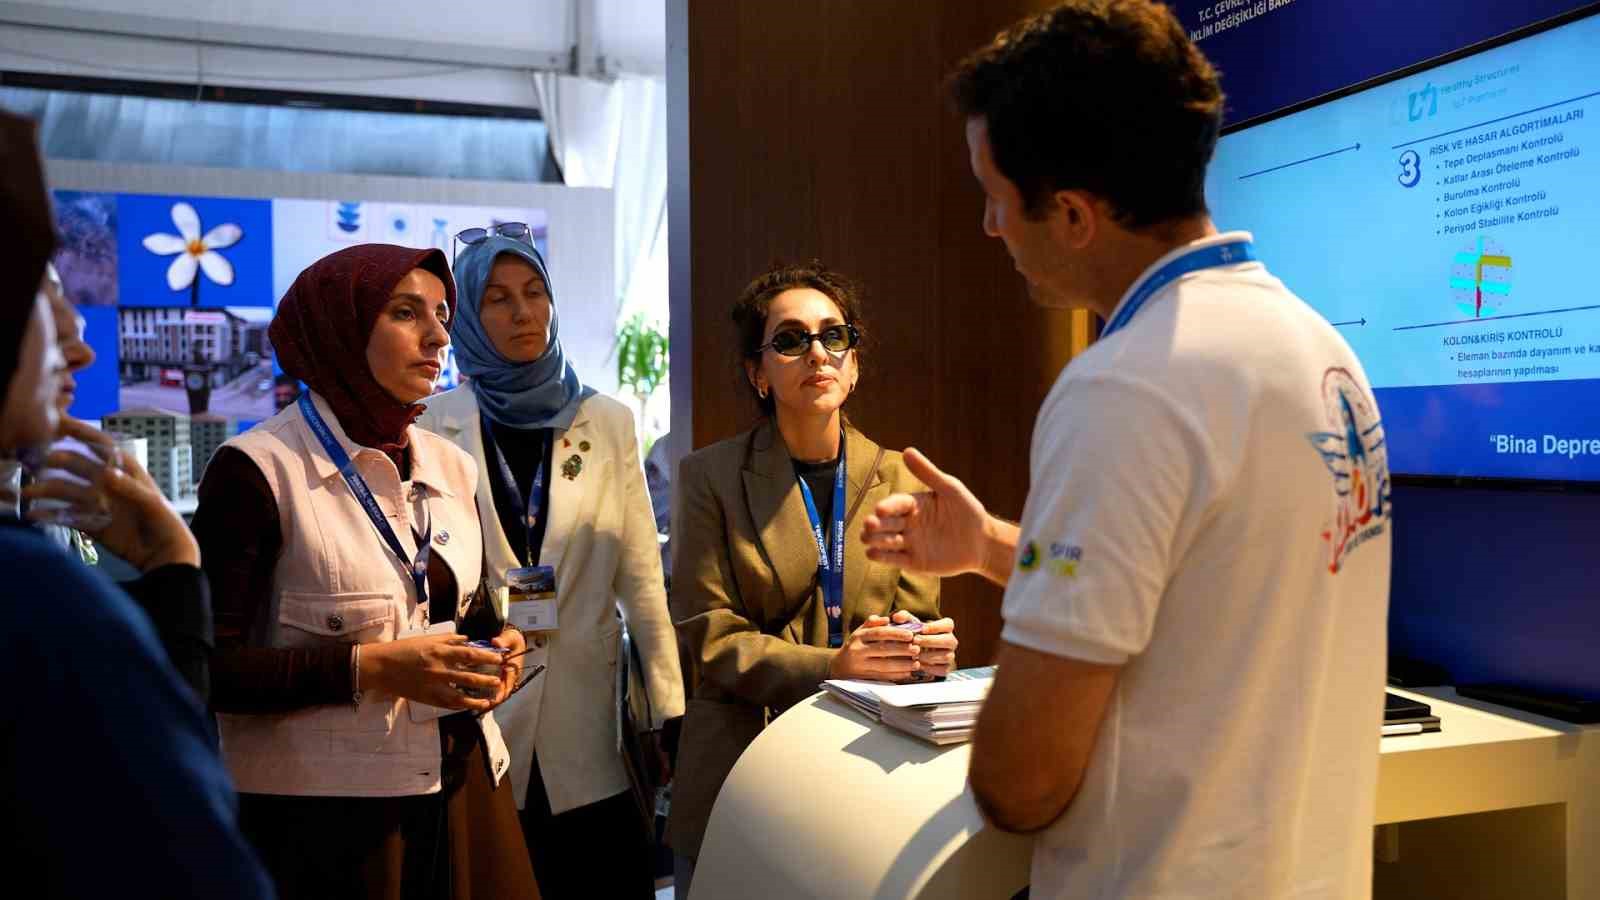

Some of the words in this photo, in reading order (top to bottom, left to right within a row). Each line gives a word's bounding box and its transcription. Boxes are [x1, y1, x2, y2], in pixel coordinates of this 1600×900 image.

[1444, 157, 1465, 169] Tepe
[1521, 131, 1564, 150] Kontrolü
[1451, 140, 1465, 151] VE
[1465, 131, 1498, 147] HASAR
[1398, 149, 1421, 188] 3
[1444, 173, 1469, 185] Katlar
[1471, 167, 1494, 179] Arası
[1536, 147, 1580, 165] Kontrolü
[1444, 187, 1480, 201] Burulma
[1481, 178, 1521, 193] Kontrolü
[1444, 207, 1469, 218] Kolon
[1444, 222, 1476, 234] Periyod
[1478, 215, 1516, 229] Stabilite
[1458, 352, 1490, 362] Eleman
[1491, 348, 1527, 360] bazında
[1575, 346, 1586, 355] ve
[1543, 434, 1600, 460] Depre
